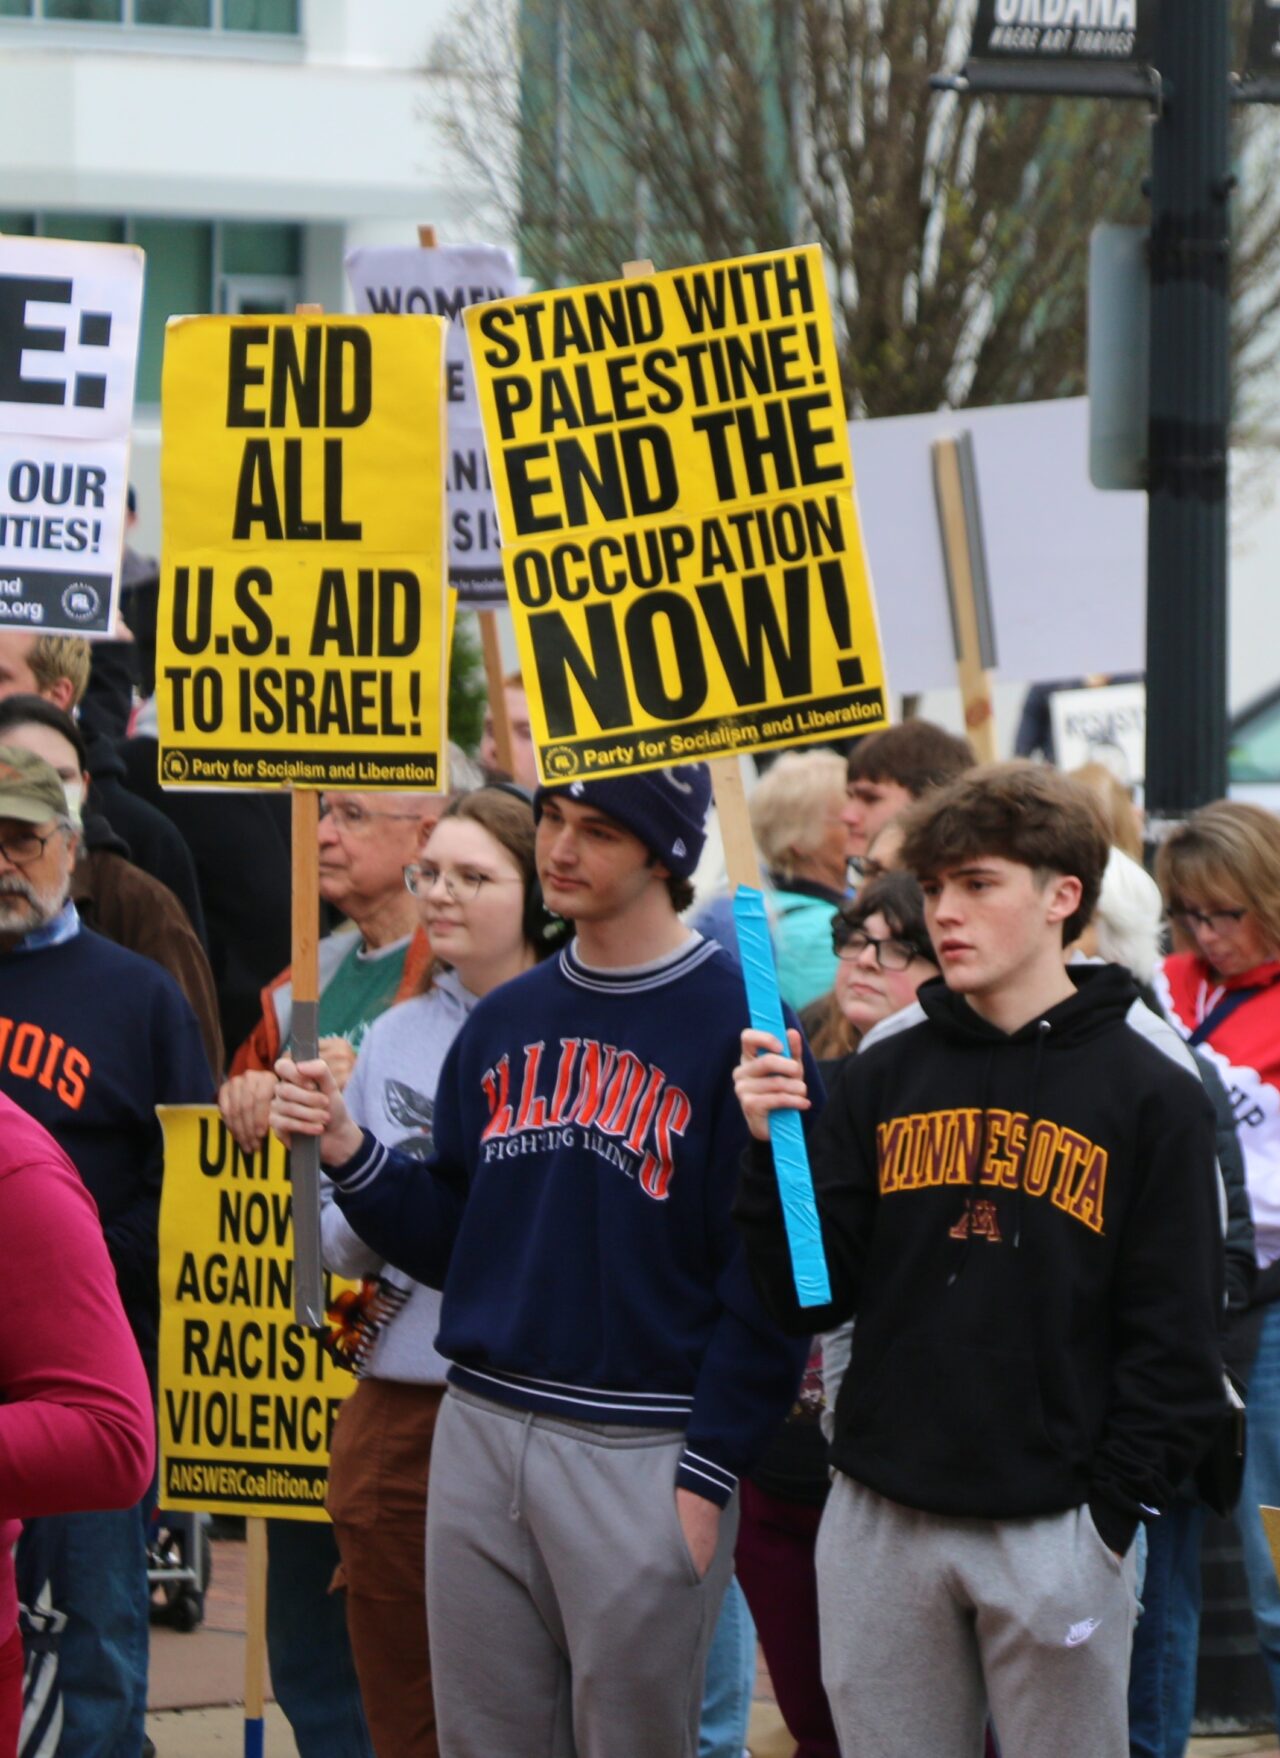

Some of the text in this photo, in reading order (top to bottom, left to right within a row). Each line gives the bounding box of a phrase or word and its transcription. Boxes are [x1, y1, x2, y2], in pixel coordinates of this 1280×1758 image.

[479, 253, 816, 369] STAND WITH
[225, 325, 373, 429] END
[491, 321, 828, 441] PALESTINE!
[8, 459, 107, 508] OUR
[231, 436, 363, 542] ALL
[502, 391, 846, 537] END THE
[512, 494, 847, 608] OCCUPATION
[171, 565, 291, 657] U.S.
[308, 567, 422, 658] AID
[526, 558, 866, 740] NOW!
[164, 665, 422, 737] TO ISRAEL!
[584, 745, 634, 769] Party
[638, 740, 667, 759] for
[670, 724, 760, 752] Socialism
[762, 714, 794, 736] and
[797, 700, 883, 731] Liberation
[192, 758, 230, 780] Party
[233, 759, 255, 776] for
[257, 760, 326, 779] Socialism
[329, 761, 355, 779] and
[359, 761, 434, 781] Liberation
[876, 1107, 1110, 1236] MINNESOTA
[175, 1251, 332, 1310] AGAIN
[183, 1318, 331, 1382] RACIST
